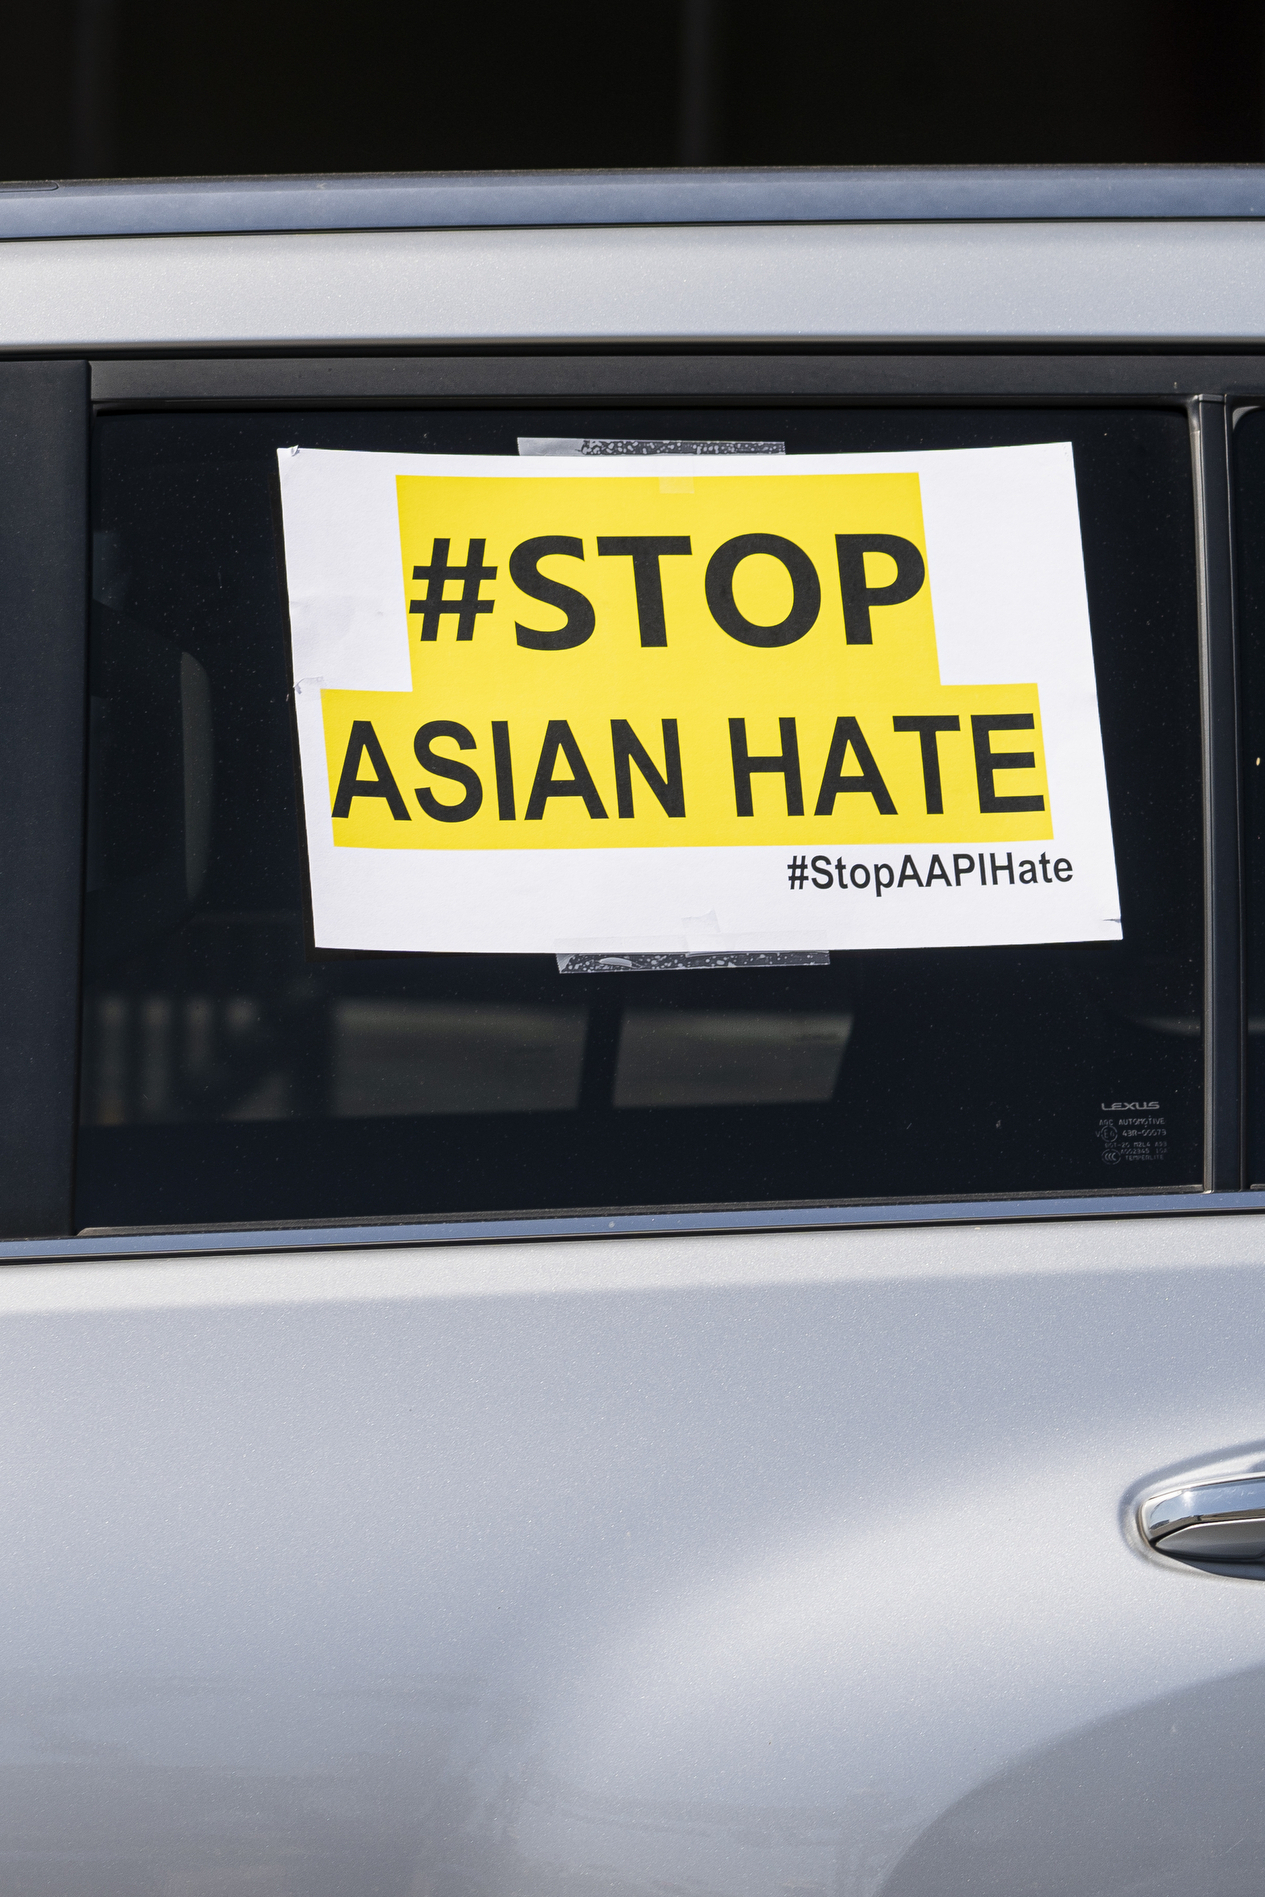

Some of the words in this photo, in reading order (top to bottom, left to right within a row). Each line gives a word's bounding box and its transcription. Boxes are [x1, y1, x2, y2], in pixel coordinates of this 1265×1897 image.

[409, 533, 925, 650] #STOP
[332, 719, 685, 822] ASIAN
[729, 714, 1044, 816] HATE
[788, 853, 1072, 897] #StopAAPIHate
[1101, 1101, 1160, 1111] LEXUS
